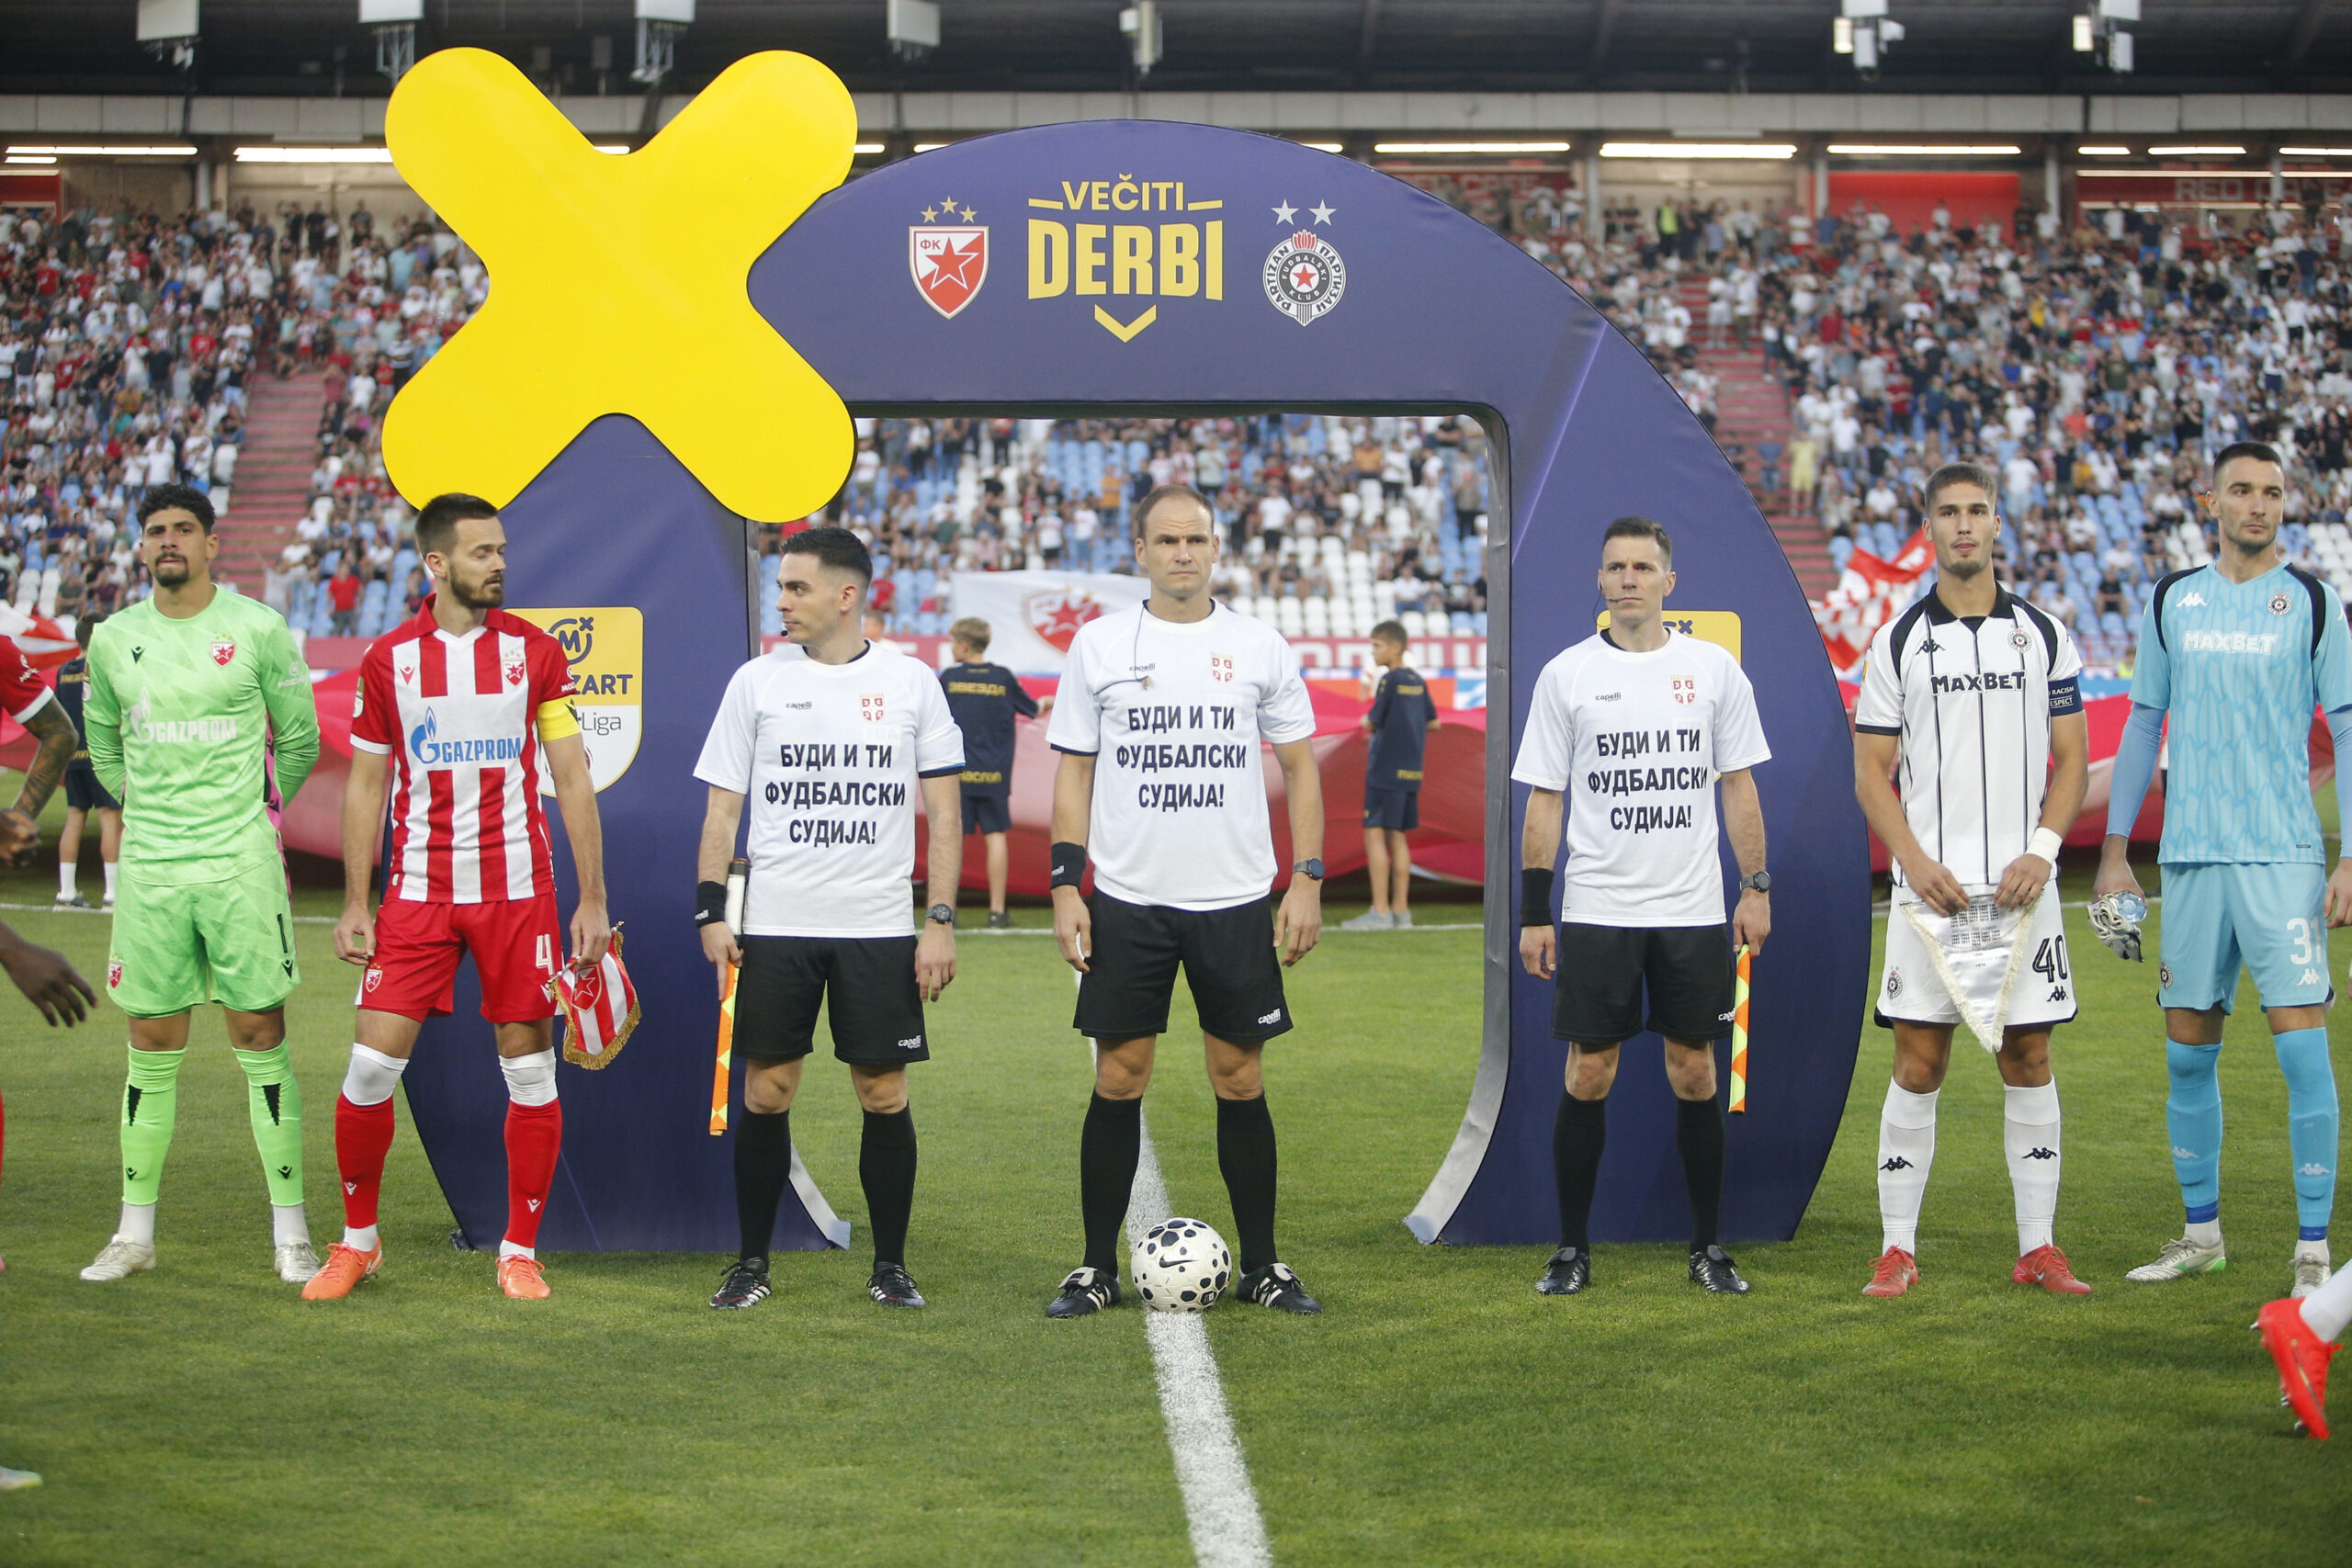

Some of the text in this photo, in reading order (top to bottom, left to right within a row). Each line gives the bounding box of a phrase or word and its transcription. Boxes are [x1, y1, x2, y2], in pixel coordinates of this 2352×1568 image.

[1061, 173, 1183, 211] VEČITI
[920, 239, 942, 251] ФК
[1028, 218, 1224, 300] DERBI
[1267, 245, 1292, 310] PARTIZAN
[1282, 254, 1328, 280] FUDBALSKI
[1317, 245, 1342, 312] ПАРТИЗАН
[1288, 289, 1320, 300] KLUB
[1129, 662, 1156, 672] capelli
[1595, 692, 1622, 702] capelli
[2050, 697, 2073, 706] ESPECT
[2052, 685, 2075, 695] RACISM
[786, 701, 812, 710] capelli
[1128, 705, 1235, 734] БУДИ И ТИ
[155, 719, 237, 743] GAZPROM
[1596, 728, 1701, 760] БУДИ И ТИ
[442, 738, 521, 763] GAZPROM
[780, 744, 892, 772] БУДИ И ТИ
[1116, 744, 1247, 773] ФУДБАЛСКИ
[765, 782, 906, 809] ФУДБАЛСКИ
[1588, 766, 1707, 797] ФУДБАЛСКИ
[1138, 784, 1225, 812] СУДИЈА!
[789, 819, 876, 848] СУДИЈА!
[1610, 805, 1691, 834] СУДИЈА!
[277, 913, 288, 953] 1
[2287, 917, 2322, 964] 31
[536, 933, 555, 976] 4
[2031, 934, 2068, 983] 40
[1258, 1008, 1281, 1024] capelli
